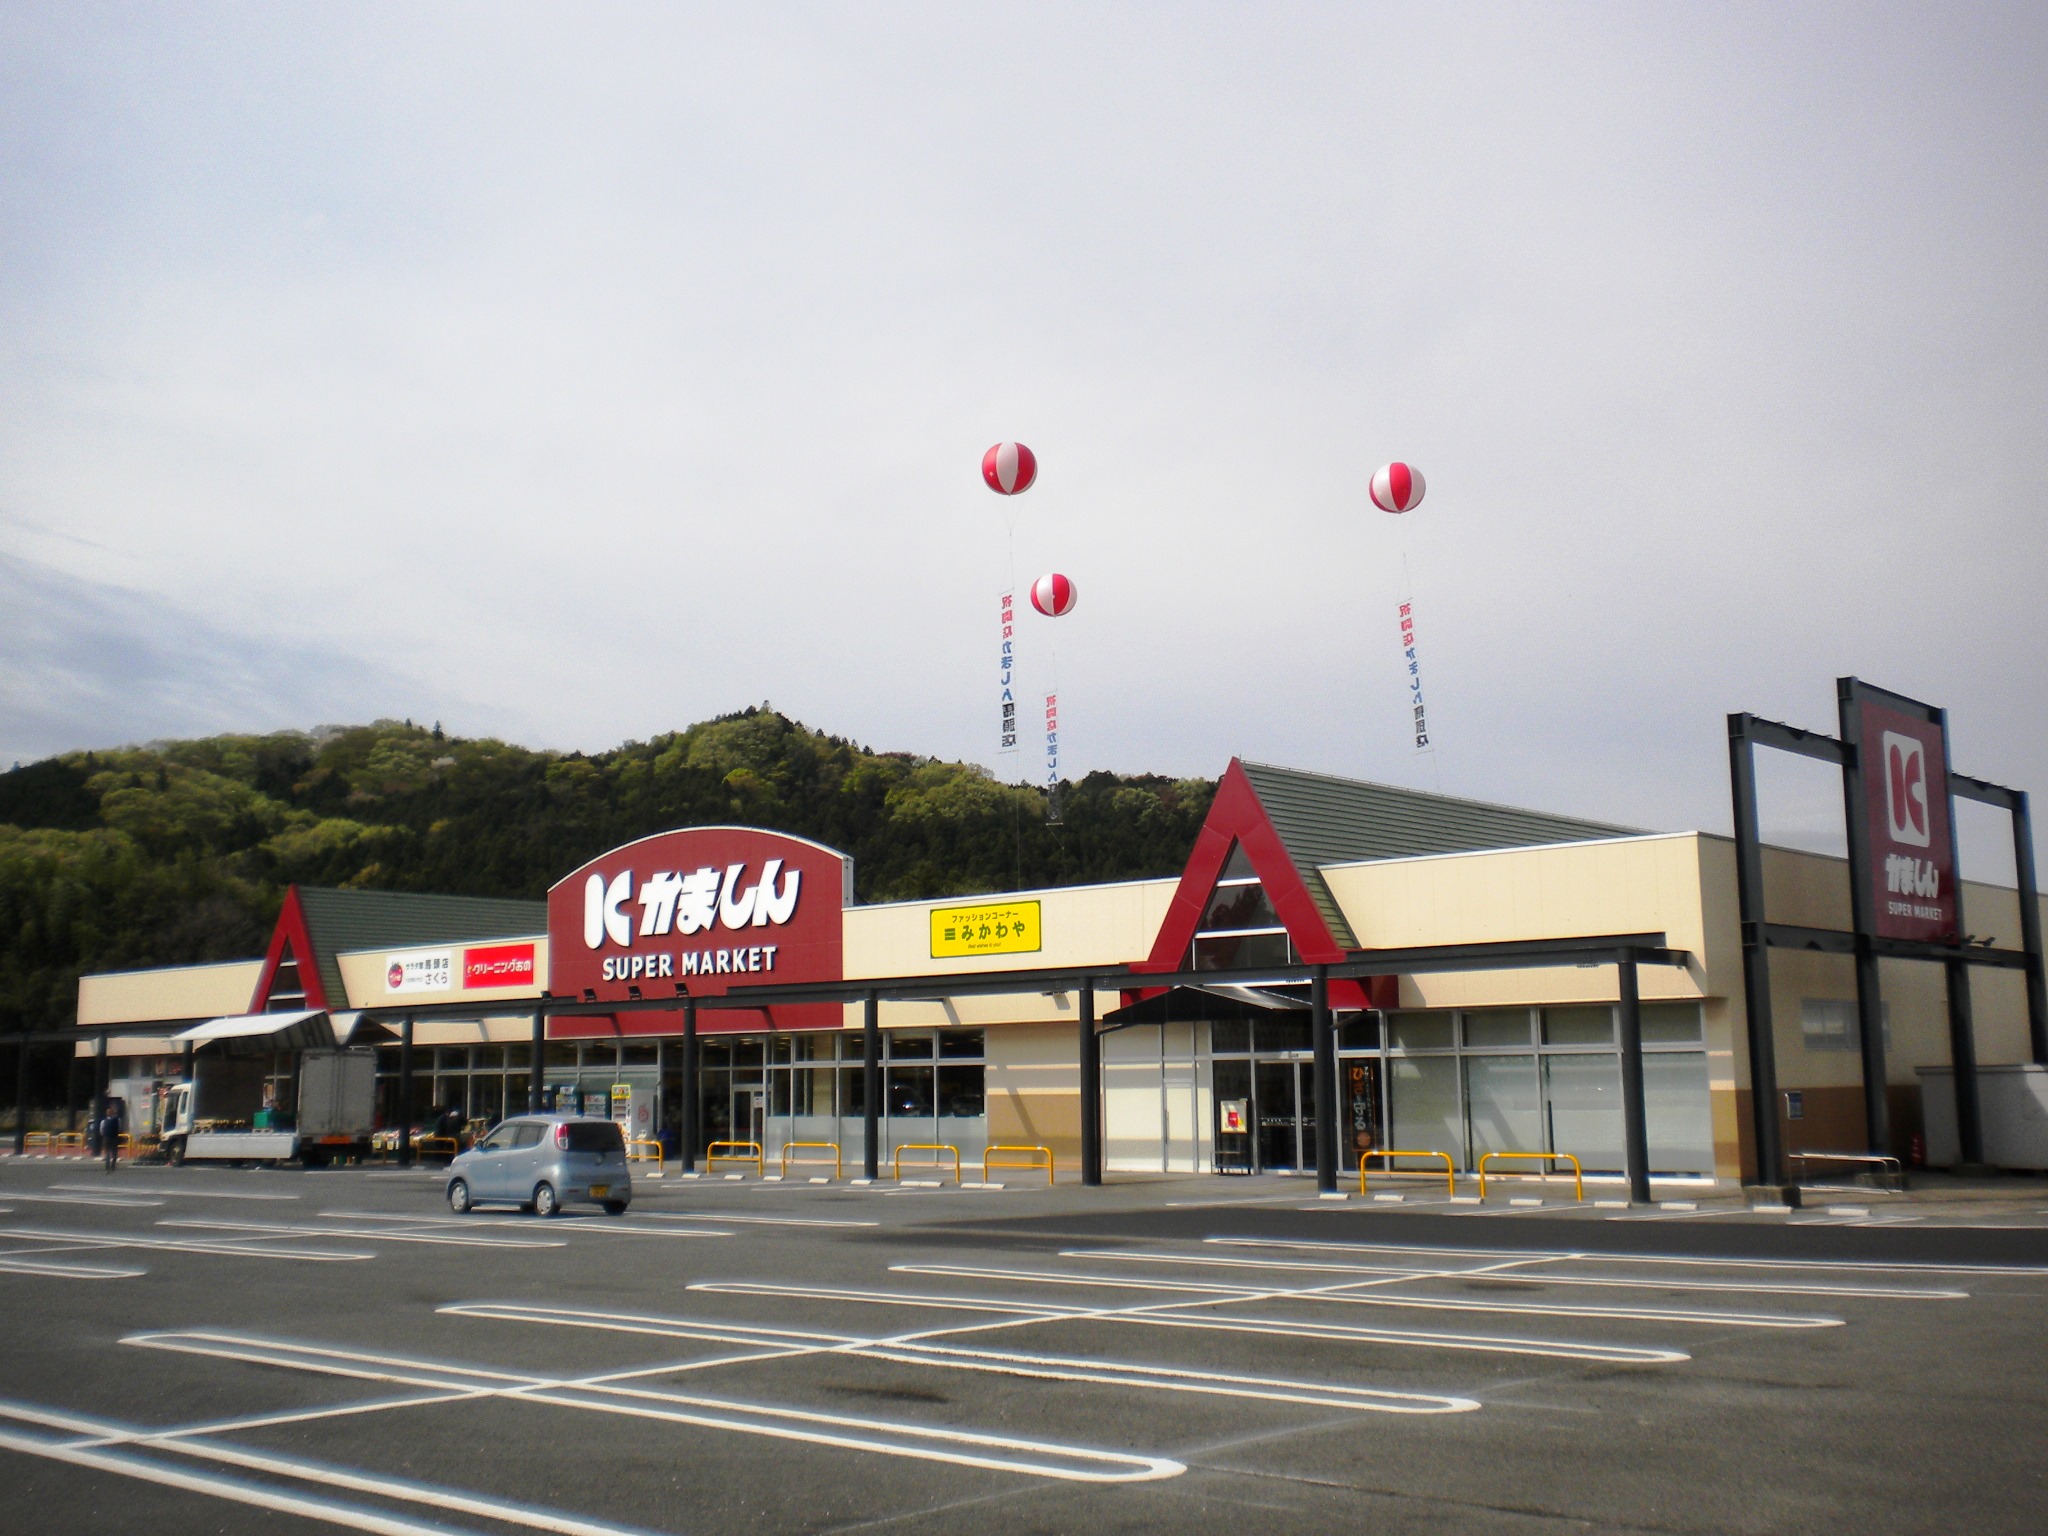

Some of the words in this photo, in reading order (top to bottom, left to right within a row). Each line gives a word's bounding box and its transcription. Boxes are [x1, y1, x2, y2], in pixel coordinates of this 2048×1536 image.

[1886, 853, 1939, 898] かましん
[637, 859, 800, 936] かましん
[1888, 901, 1912, 916] SUPER
[1914, 905, 1942, 920] MARKET
[952, 910, 1019, 923] ファッションコーナー
[602, 953, 673, 981] SUPER
[681, 946, 777, 976] MARKET
[425, 971, 448, 985] さくら
